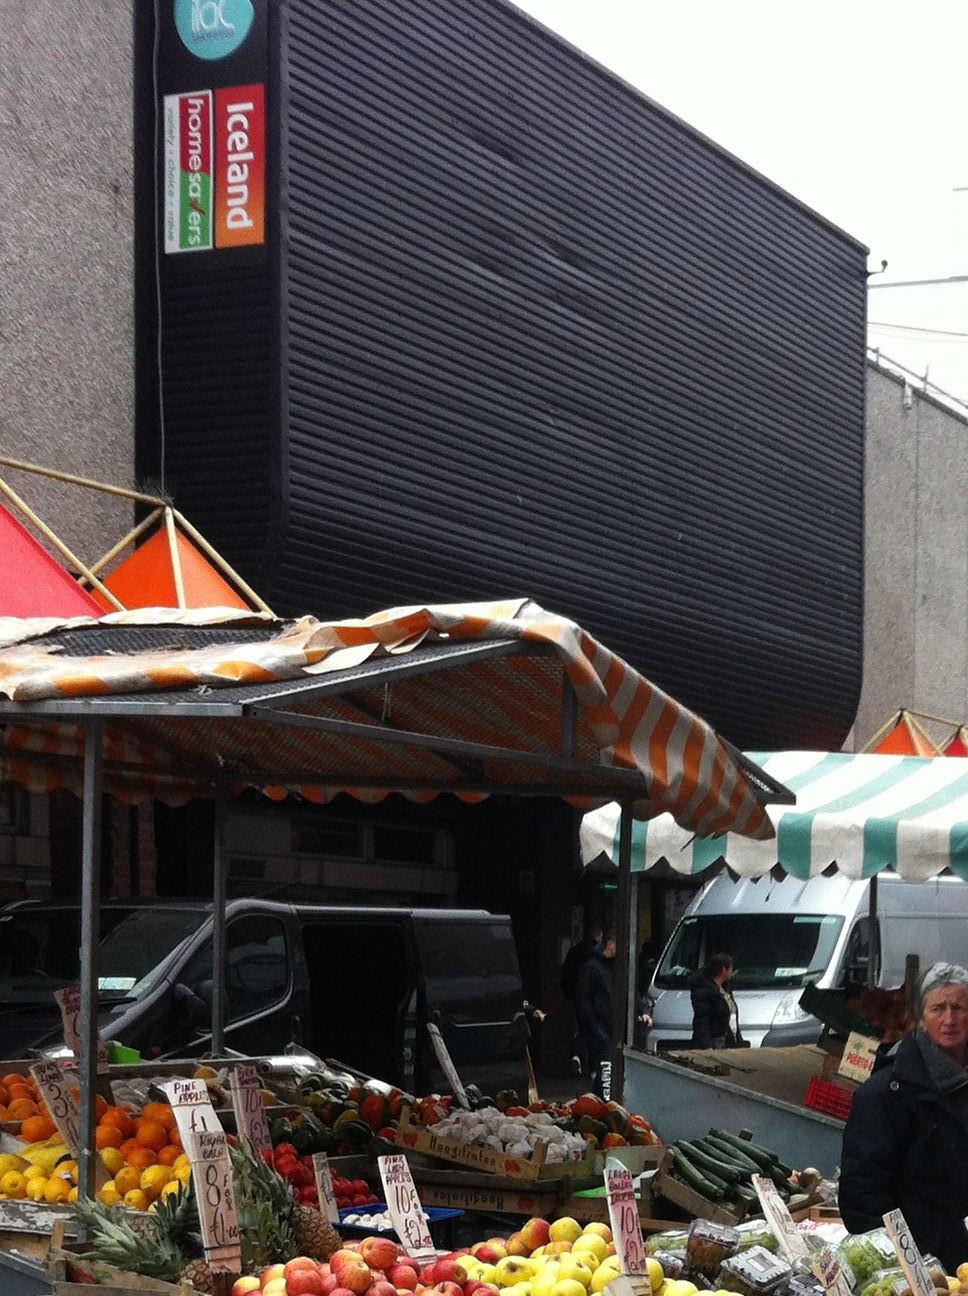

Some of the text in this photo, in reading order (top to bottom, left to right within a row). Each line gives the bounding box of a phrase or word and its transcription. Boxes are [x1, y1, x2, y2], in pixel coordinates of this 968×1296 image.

[226, 101, 255, 230] Iceland
[173, 1082, 197, 1094] PINE
[205, 1163, 222, 1207] 8
[394, 1185, 411, 1215] 10
[621, 1206, 636, 1234] 10
[900, 1233, 917, 1265] 8
